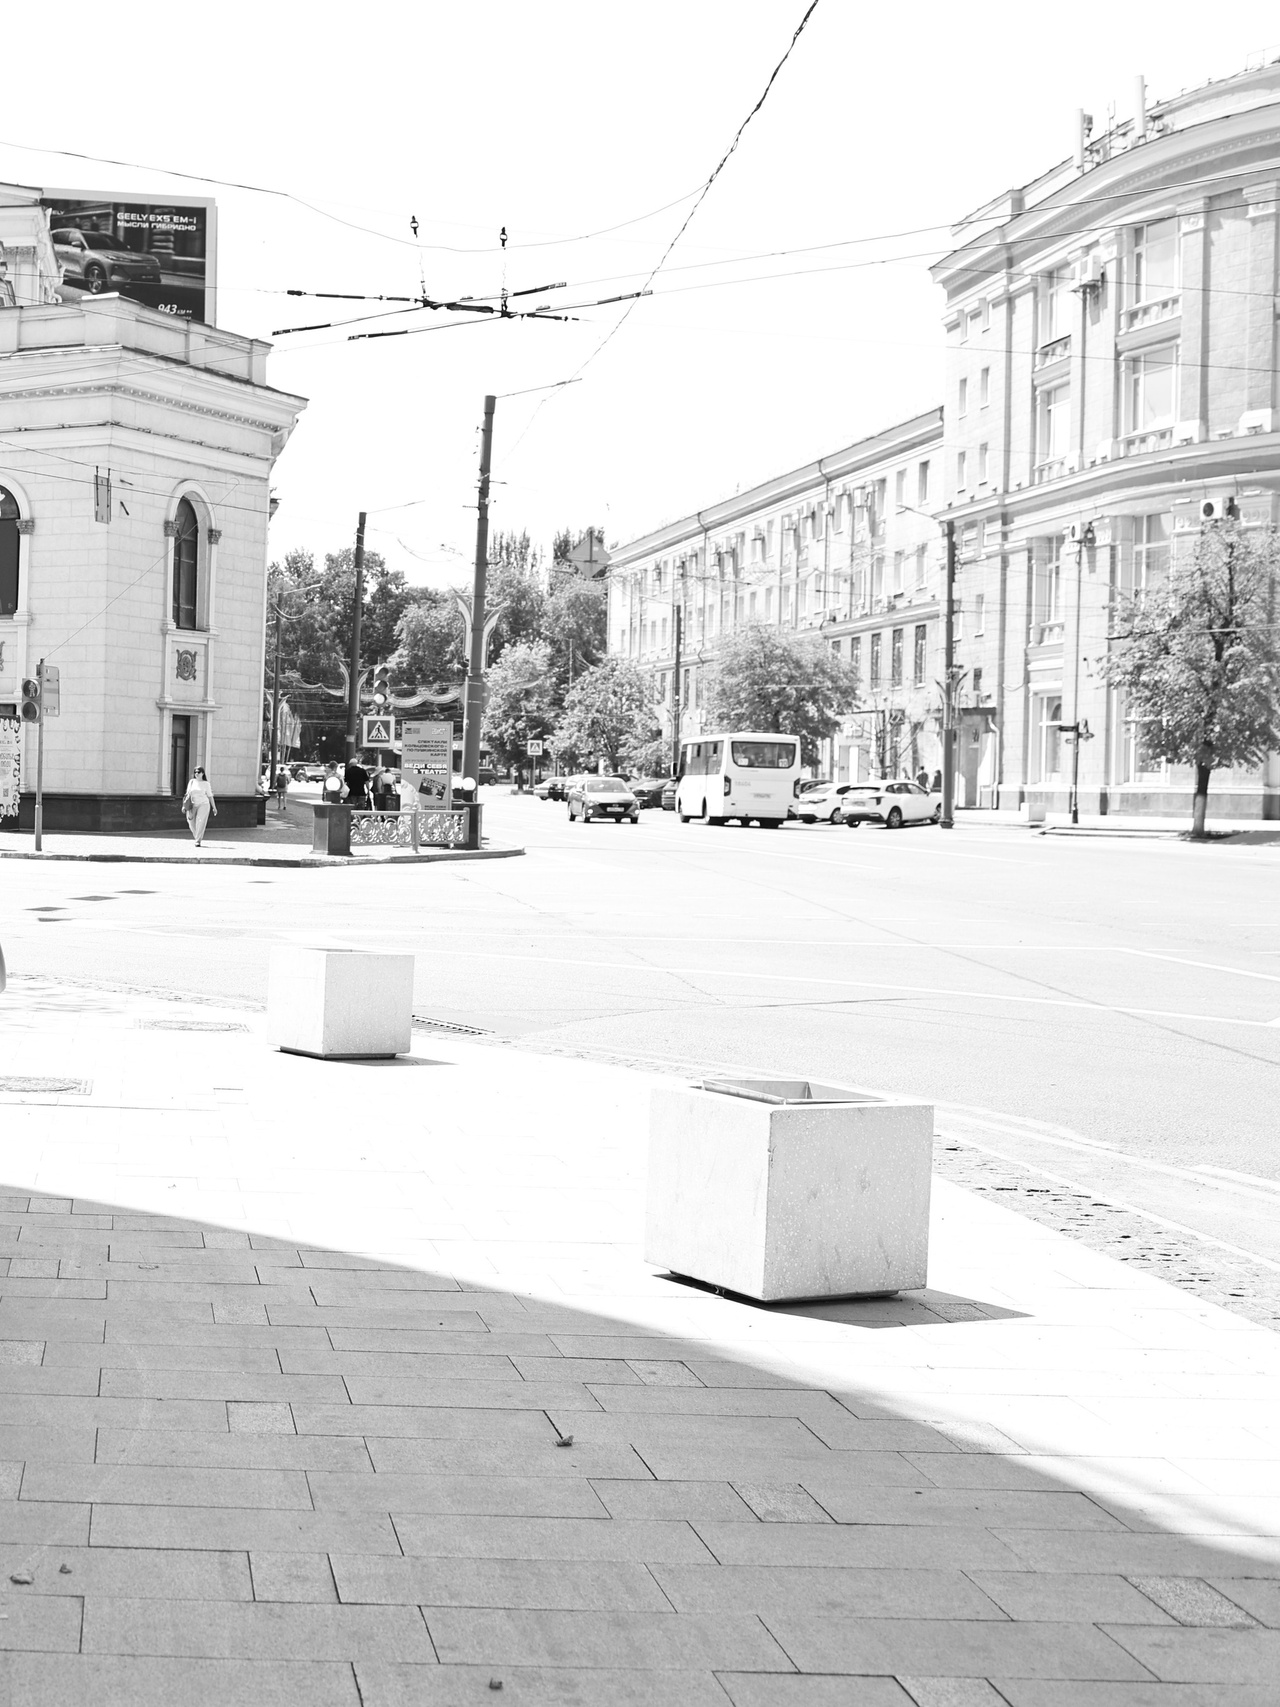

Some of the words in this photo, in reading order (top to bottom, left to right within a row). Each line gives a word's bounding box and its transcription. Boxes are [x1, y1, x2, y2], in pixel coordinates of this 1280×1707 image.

[116, 212, 148, 221] GEELY
[149, 214, 170, 222] EX5
[151, 223, 197, 231] ГИБРИДНО
